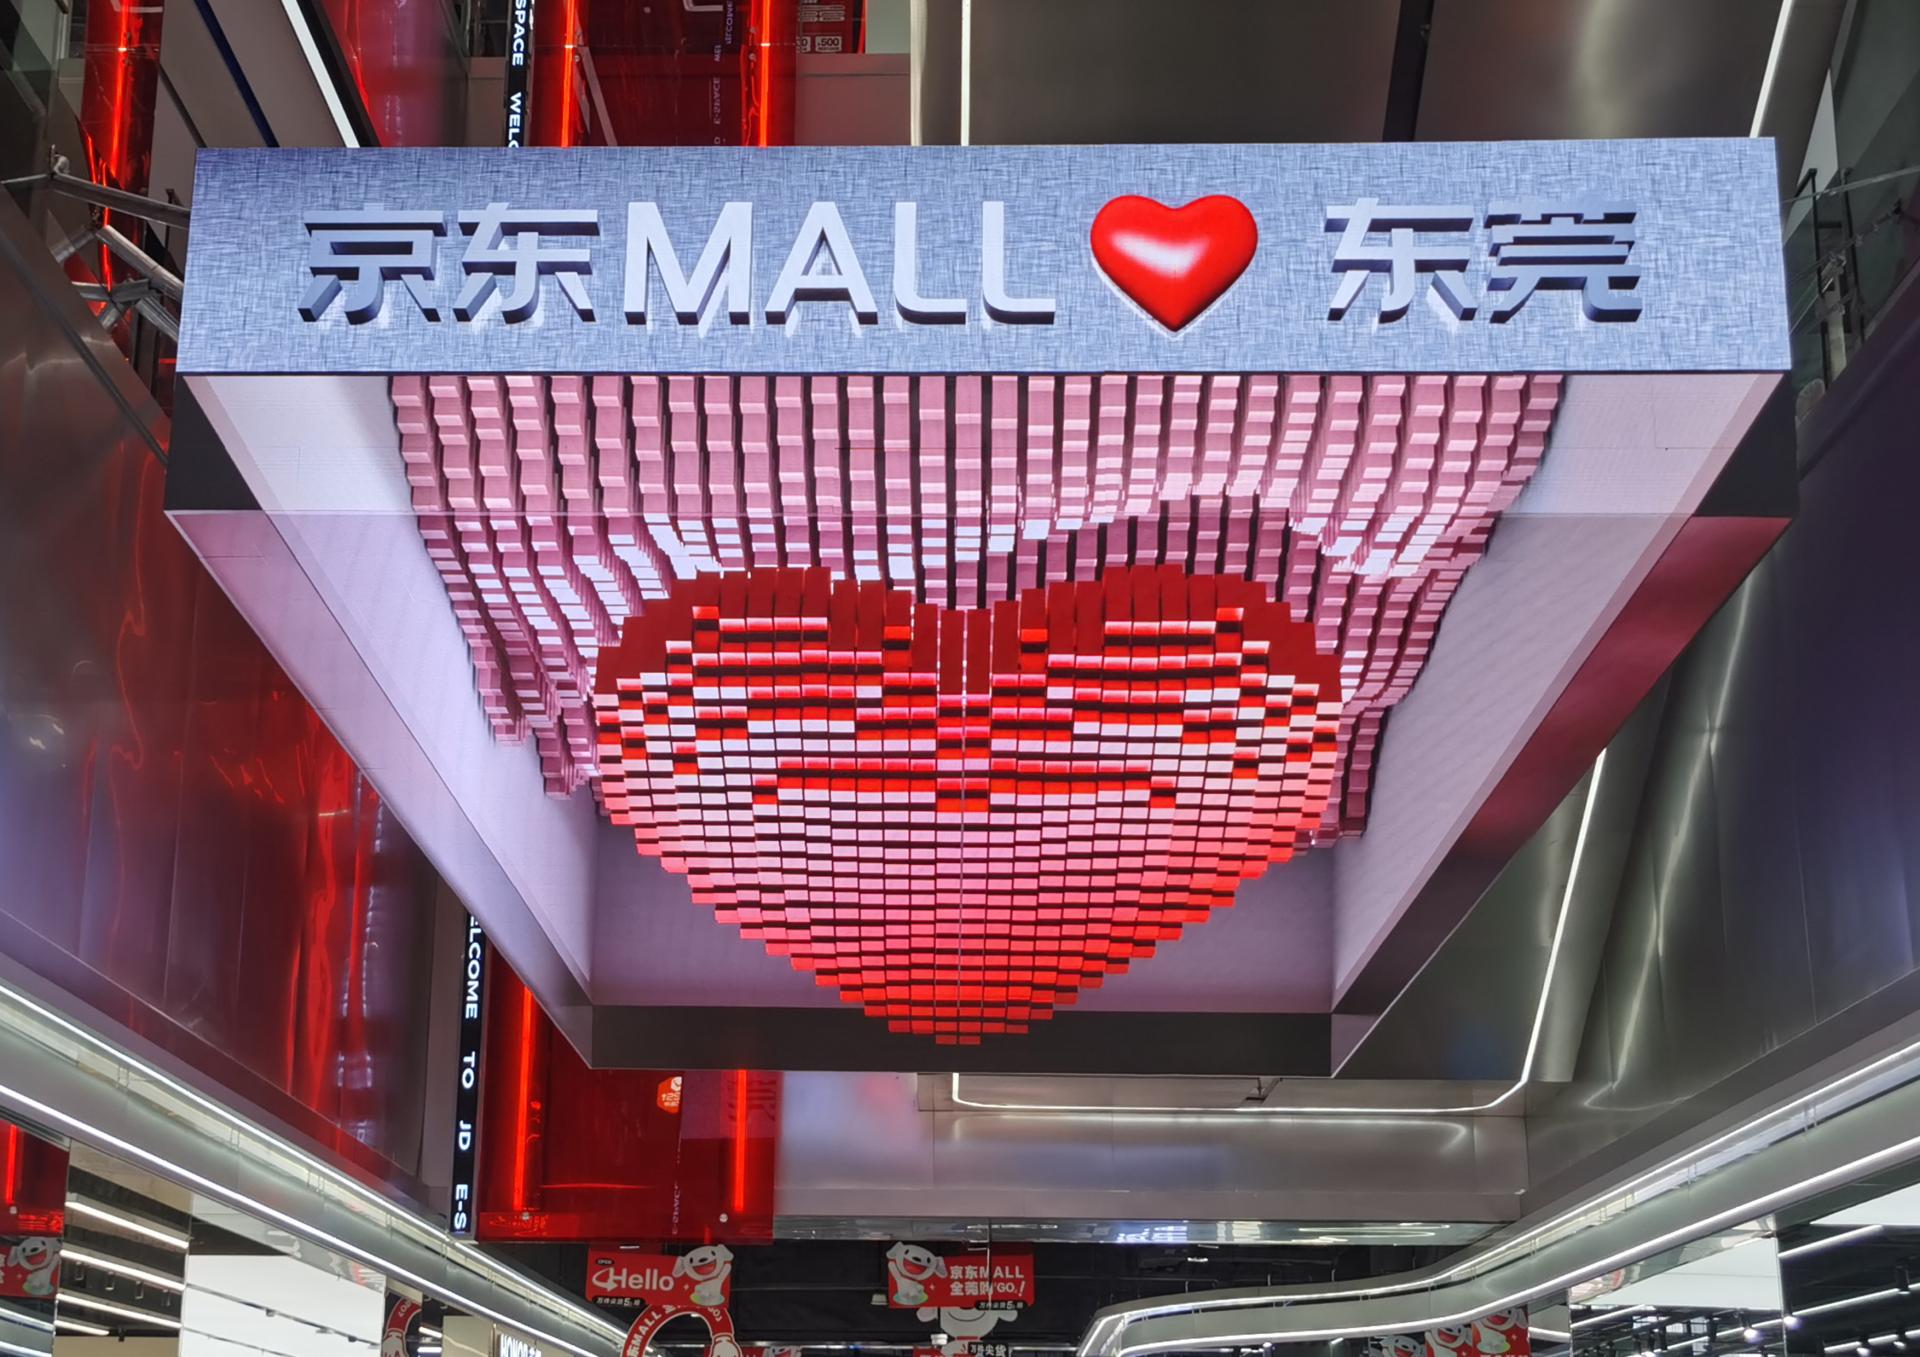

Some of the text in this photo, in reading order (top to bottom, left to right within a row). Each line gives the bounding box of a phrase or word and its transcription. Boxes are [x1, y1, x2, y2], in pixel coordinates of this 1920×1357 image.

[1324, 197, 1643, 324] 东莞
[462, 1051, 476, 1089] TO
[459, 1120, 472, 1150] JD
[454, 1184, 469, 1229] E-S
[593, 1267, 675, 1292] Hello
